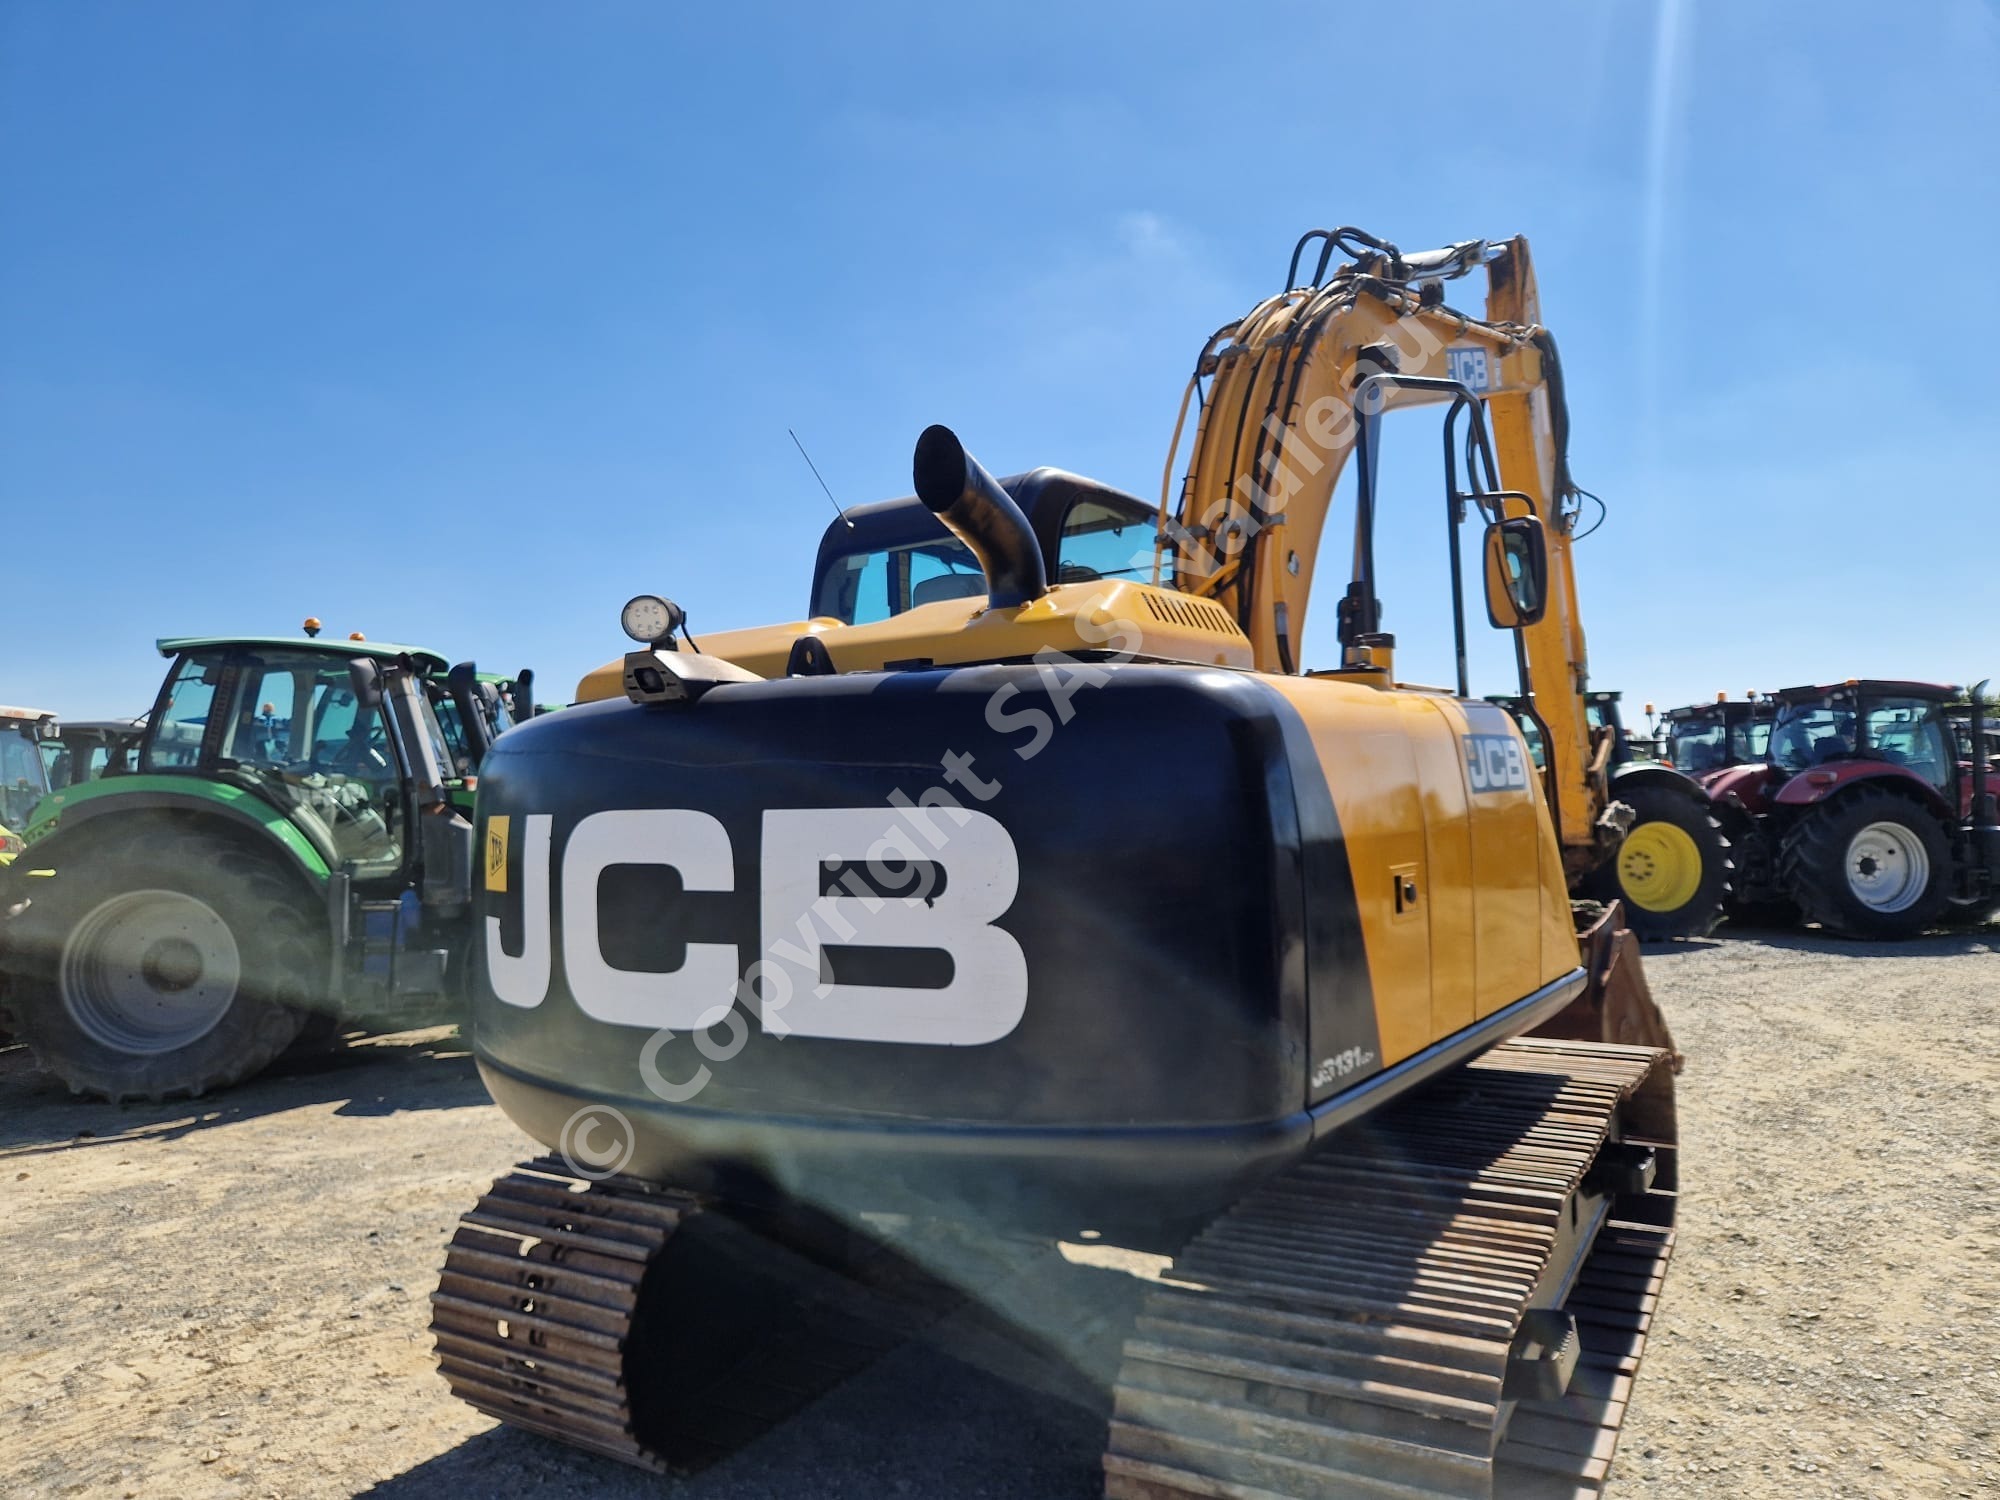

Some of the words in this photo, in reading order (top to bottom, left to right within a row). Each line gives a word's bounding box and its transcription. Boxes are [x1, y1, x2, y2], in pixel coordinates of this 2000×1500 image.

[1448, 351, 1489, 388] JCB
[1469, 738, 1525, 788] JCB
[485, 807, 1028, 1047] JCB
